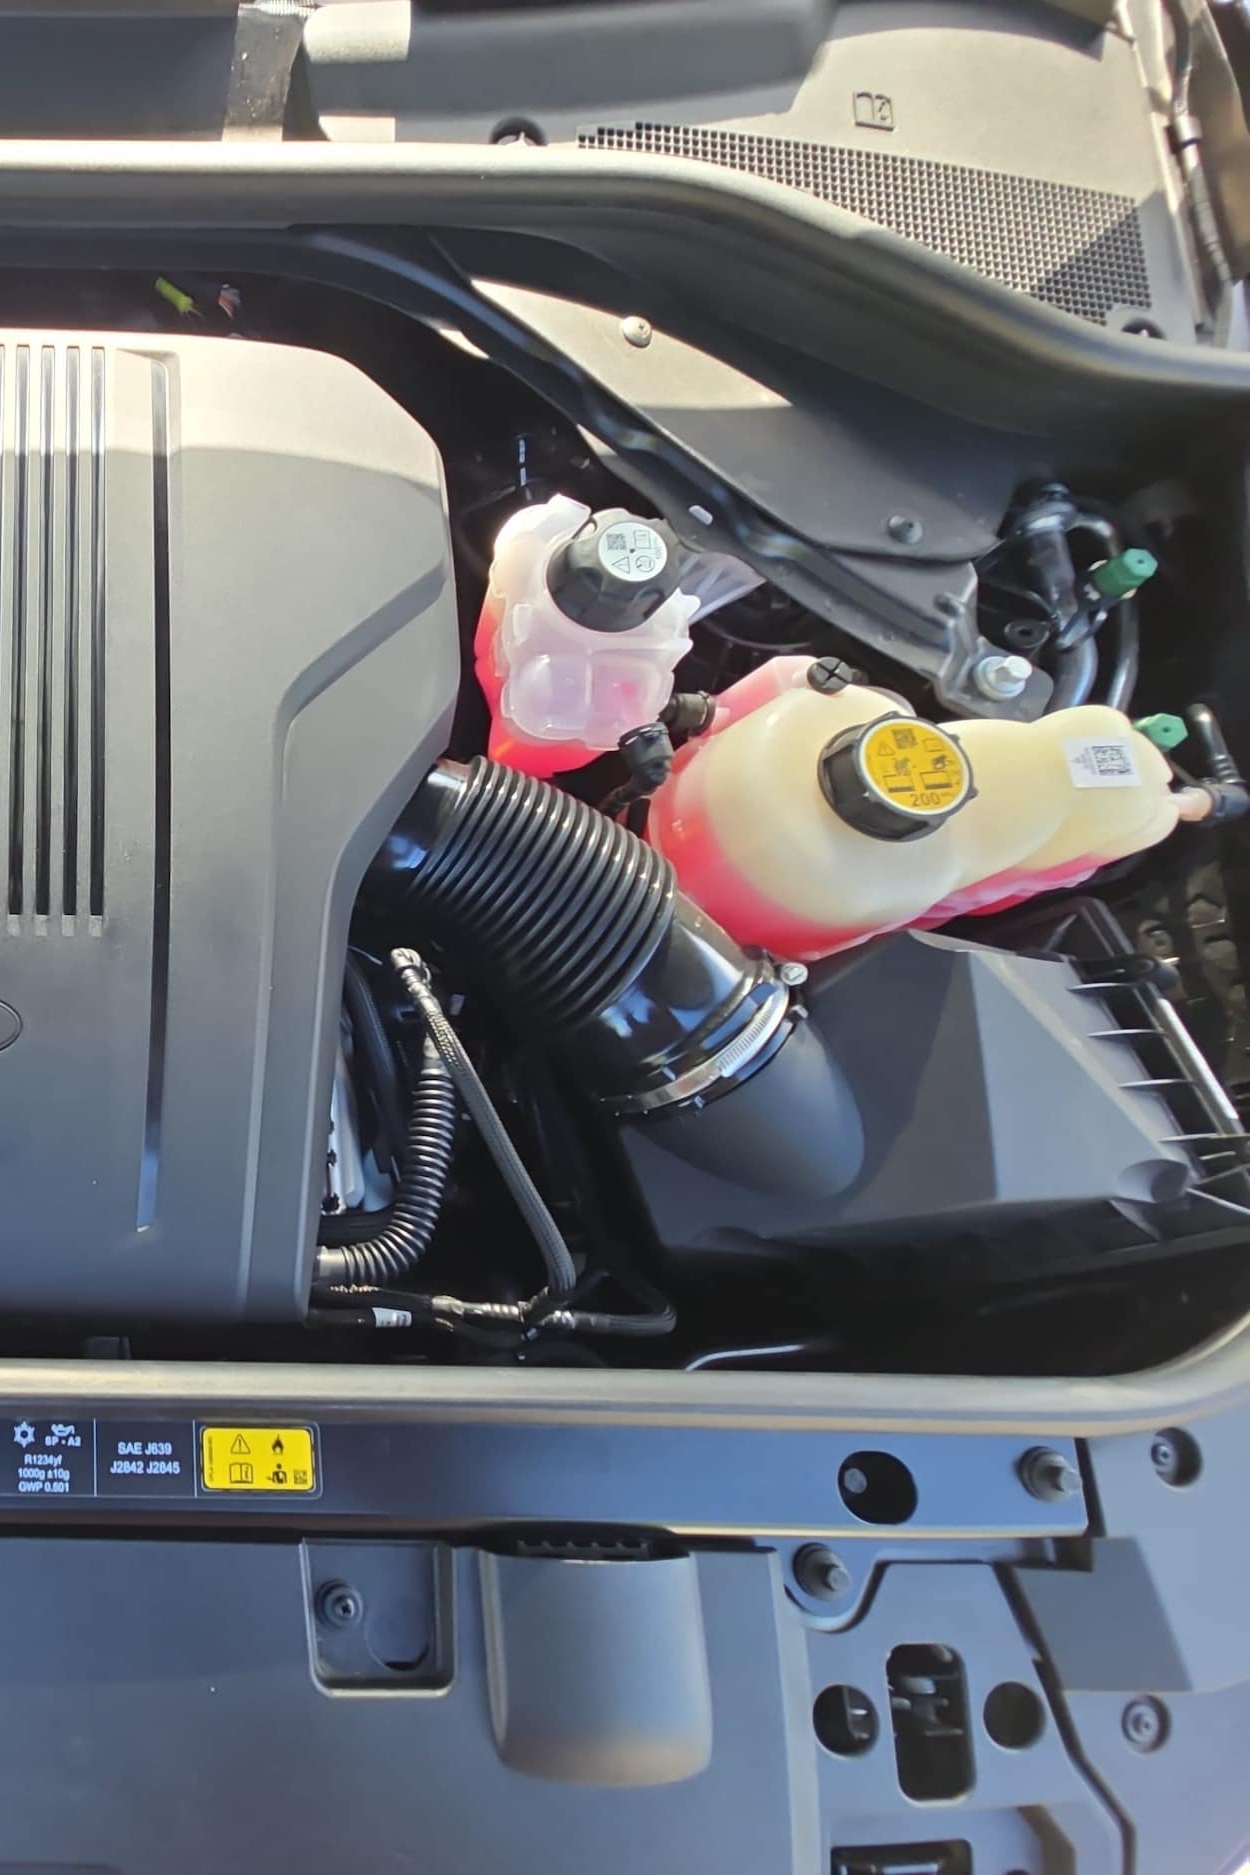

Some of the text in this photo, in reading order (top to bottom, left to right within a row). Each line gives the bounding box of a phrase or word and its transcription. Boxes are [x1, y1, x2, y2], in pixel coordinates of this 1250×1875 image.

[118, 1442, 172, 1455] SAE J639
[24, 1454, 62, 1467] R1234yf
[18, 1467, 45, 1480] 1000g
[110, 1461, 144, 1474] J2842
[18, 1481, 43, 1493] GWP
